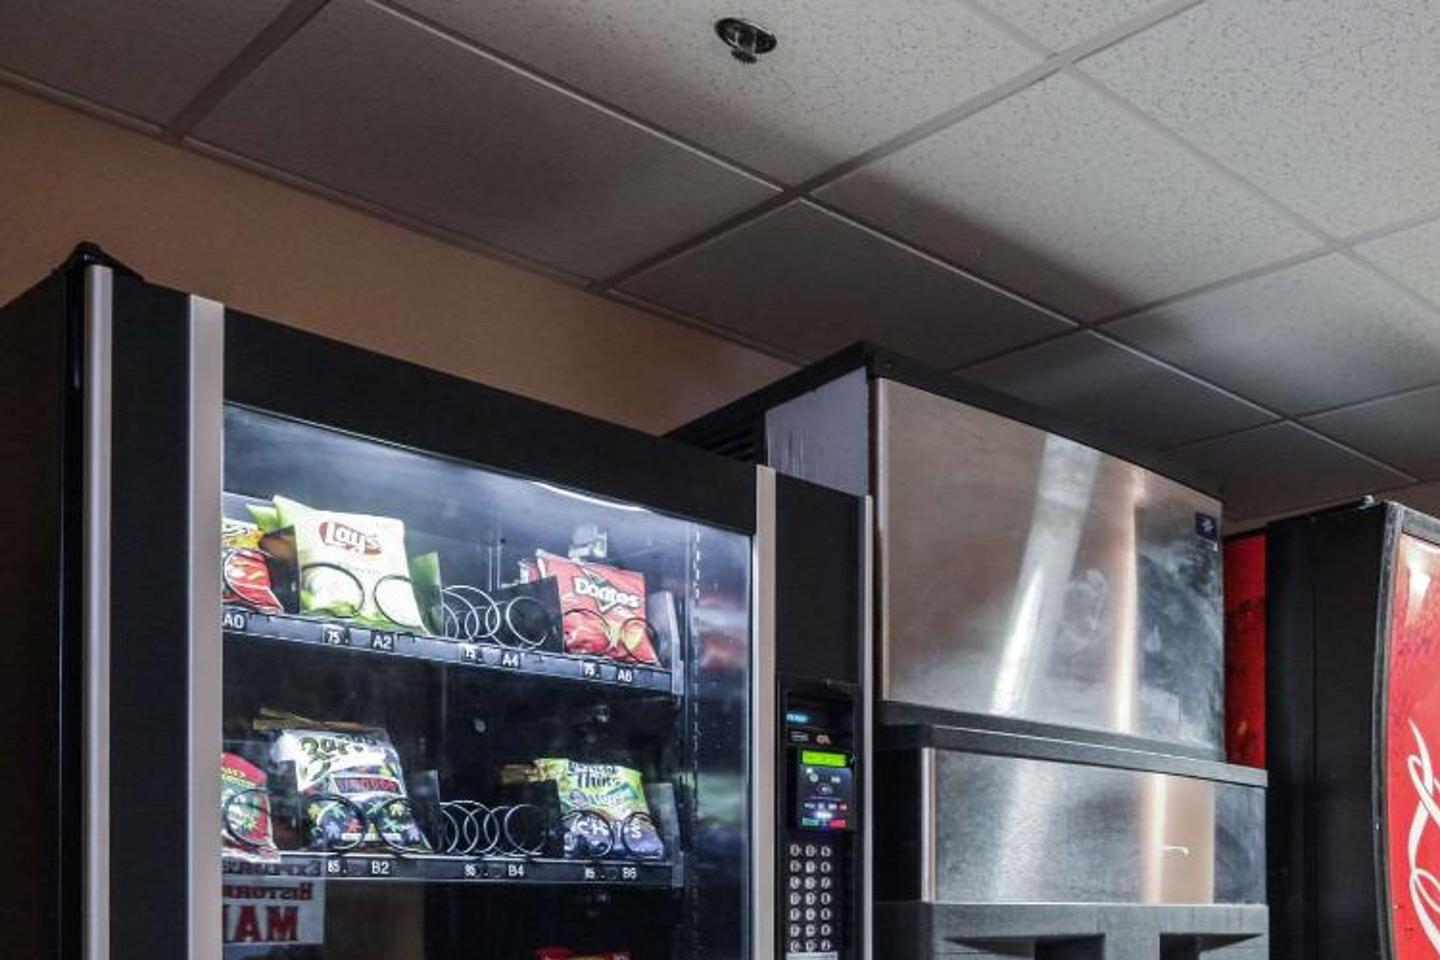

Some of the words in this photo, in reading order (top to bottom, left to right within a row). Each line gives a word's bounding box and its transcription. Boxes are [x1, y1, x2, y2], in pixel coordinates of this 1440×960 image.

[574, 576, 641, 609] Doritos
[372, 634, 393, 649] A2
[502, 655, 519, 667] A4
[371, 860, 390, 874] B2
[508, 864, 525, 877] B4
